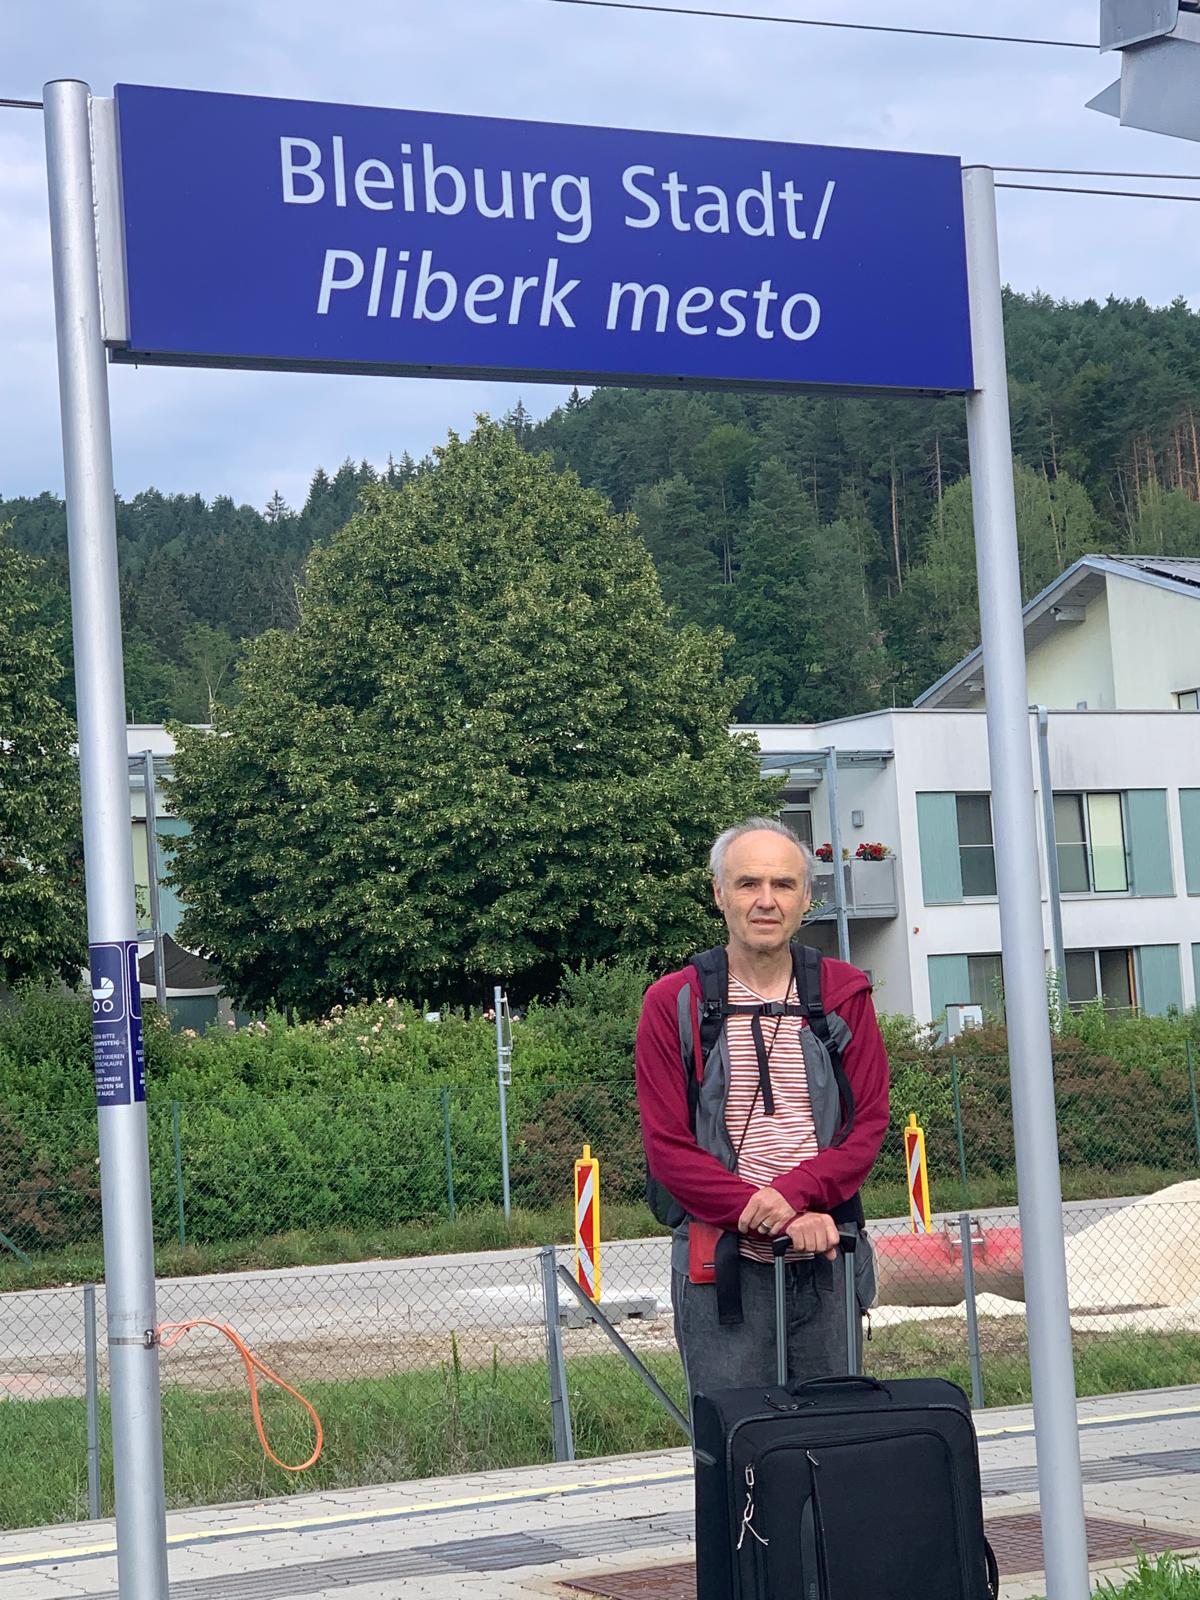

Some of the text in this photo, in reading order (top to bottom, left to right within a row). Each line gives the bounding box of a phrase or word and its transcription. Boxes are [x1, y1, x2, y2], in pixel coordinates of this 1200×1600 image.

[279, 135, 836, 244] Bleiburg Stadt/
[316, 247, 821, 341] Pliberk mesto
